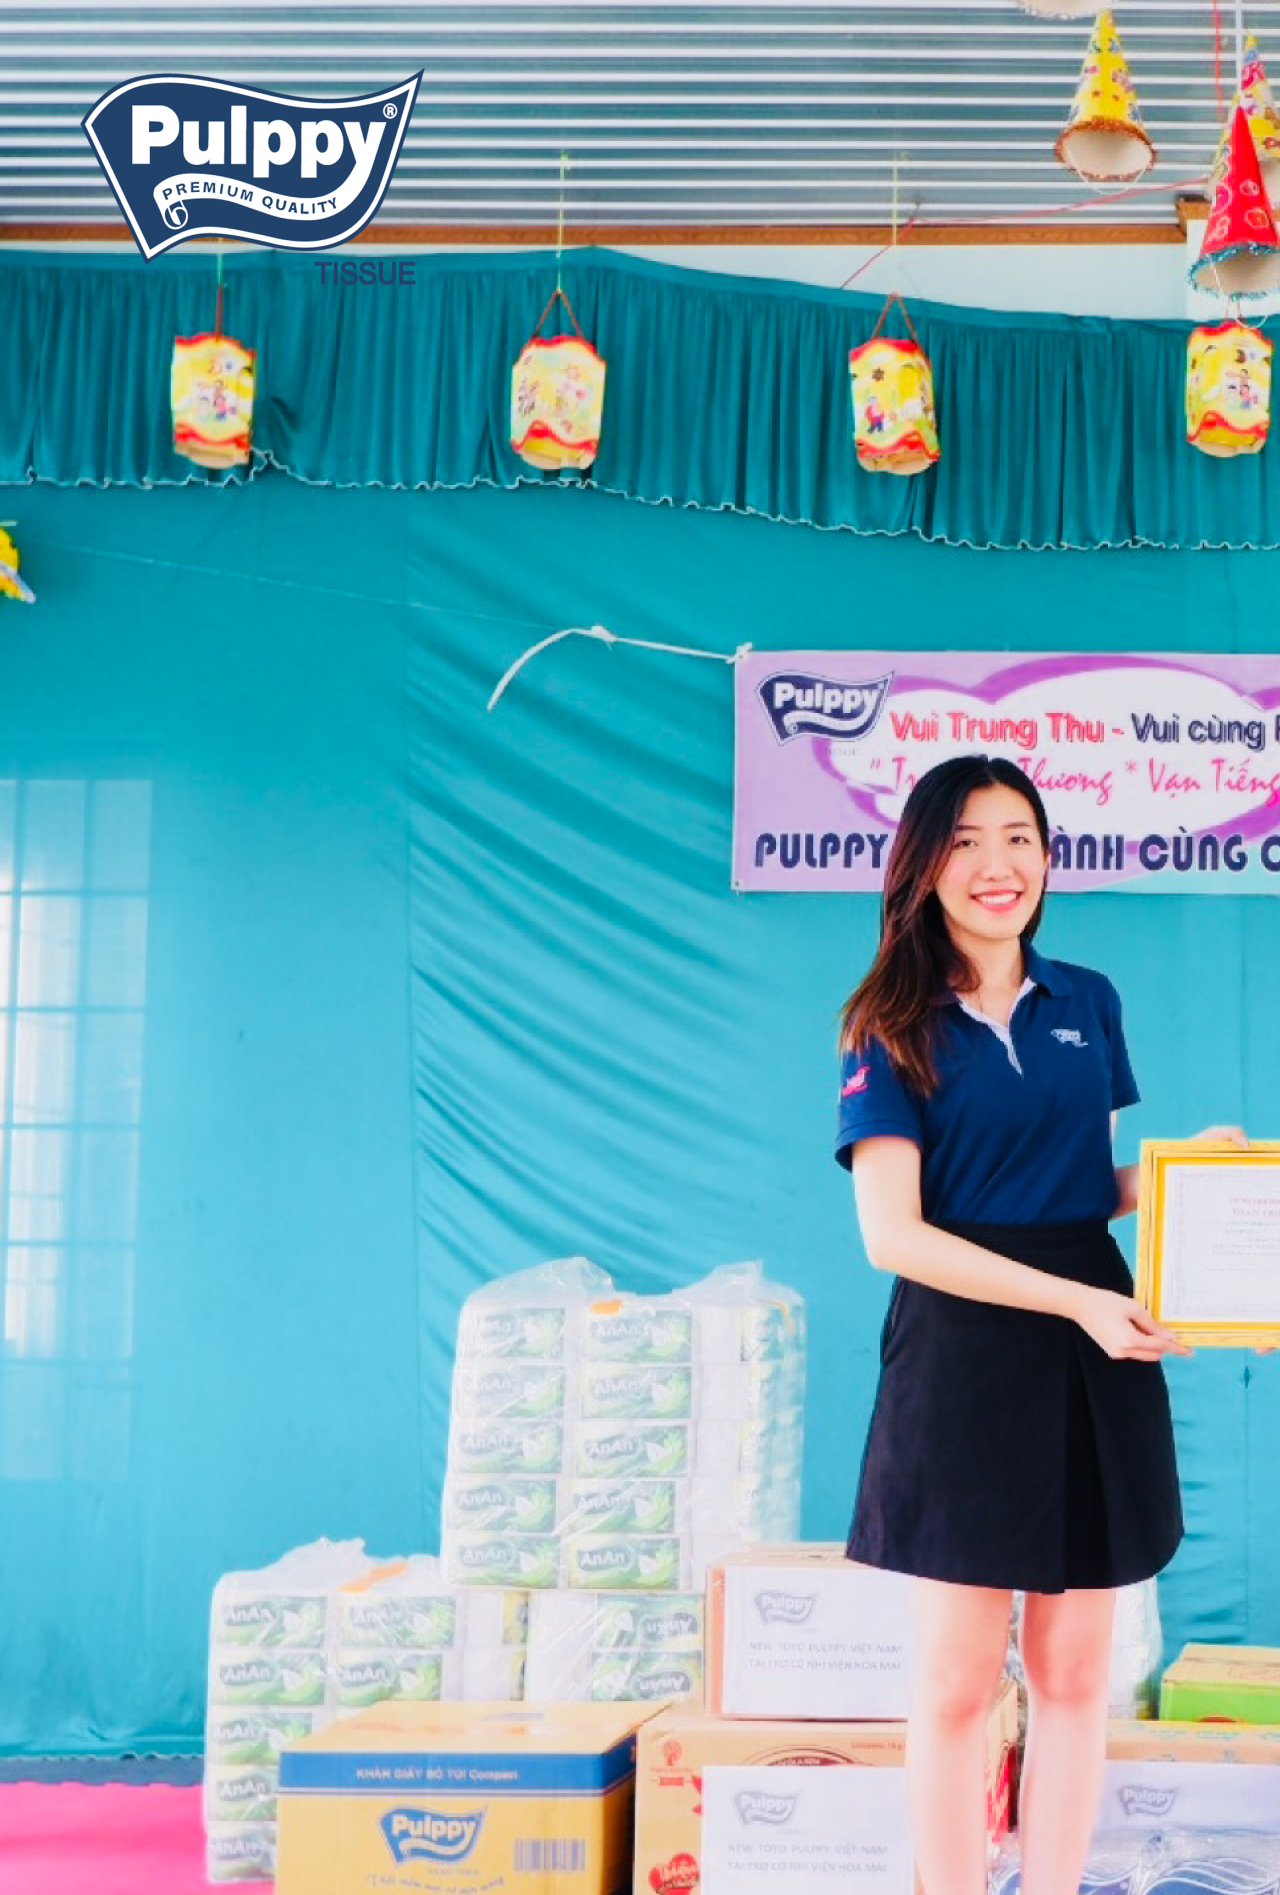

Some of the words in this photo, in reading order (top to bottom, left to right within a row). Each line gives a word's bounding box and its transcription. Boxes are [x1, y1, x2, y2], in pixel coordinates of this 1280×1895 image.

[775, 682, 879, 713] Pulppy
[889, 711, 939, 742] Vui
[947, 711, 1038, 750] Trung
[1045, 711, 1106, 742] Thu
[1131, 712, 1180, 742] Vui
[1187, 713, 1266, 752] cùng
[1148, 757, 1202, 798] Vạn
[754, 832, 889, 869] PULPPY
[1050, 825, 1125, 871] ÀNH
[1138, 825, 1249, 871] CÙNG
[587, 1439, 634, 1455] AnAn
[462, 1548, 508, 1564] AnAn
[579, 1552, 626, 1568] AnAn
[762, 1594, 813, 1612] Pulppy
[223, 1666, 271, 1684] AnAn
[219, 1780, 266, 1797] AnAn
[1123, 1788, 1174, 1803] Pulppy
[741, 1794, 792, 1812] Pulppy
[392, 1813, 477, 1840] Pulppy
